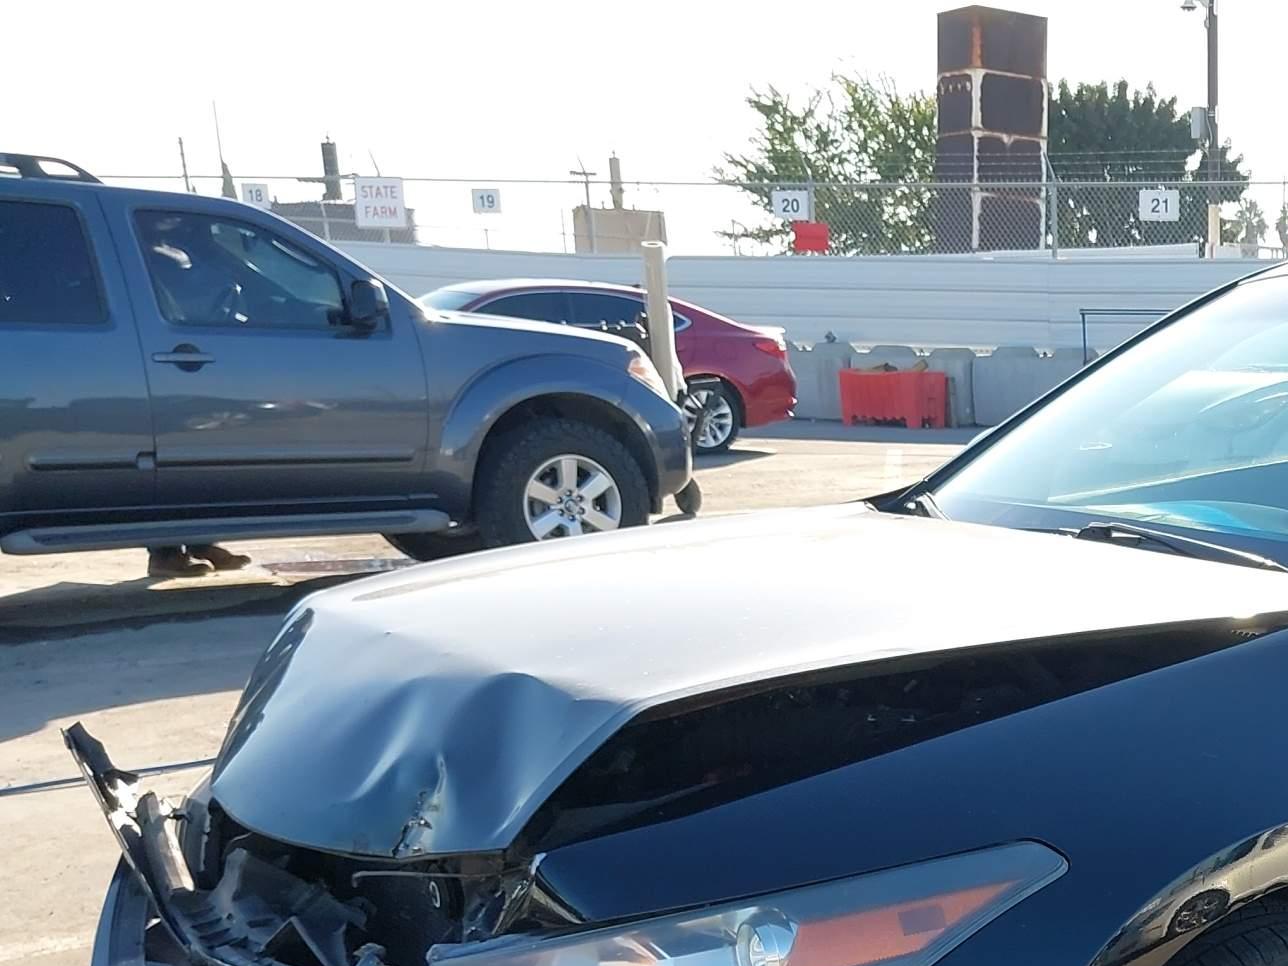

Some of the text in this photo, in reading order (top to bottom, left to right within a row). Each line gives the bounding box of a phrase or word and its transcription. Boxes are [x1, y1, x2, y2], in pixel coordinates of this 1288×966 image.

[248, 189, 262, 202] 18
[361, 185, 398, 199] STATE
[479, 194, 495, 208] 19
[782, 198, 800, 213] 20
[1151, 198, 1169, 213] 21
[364, 206, 399, 219] FARM
